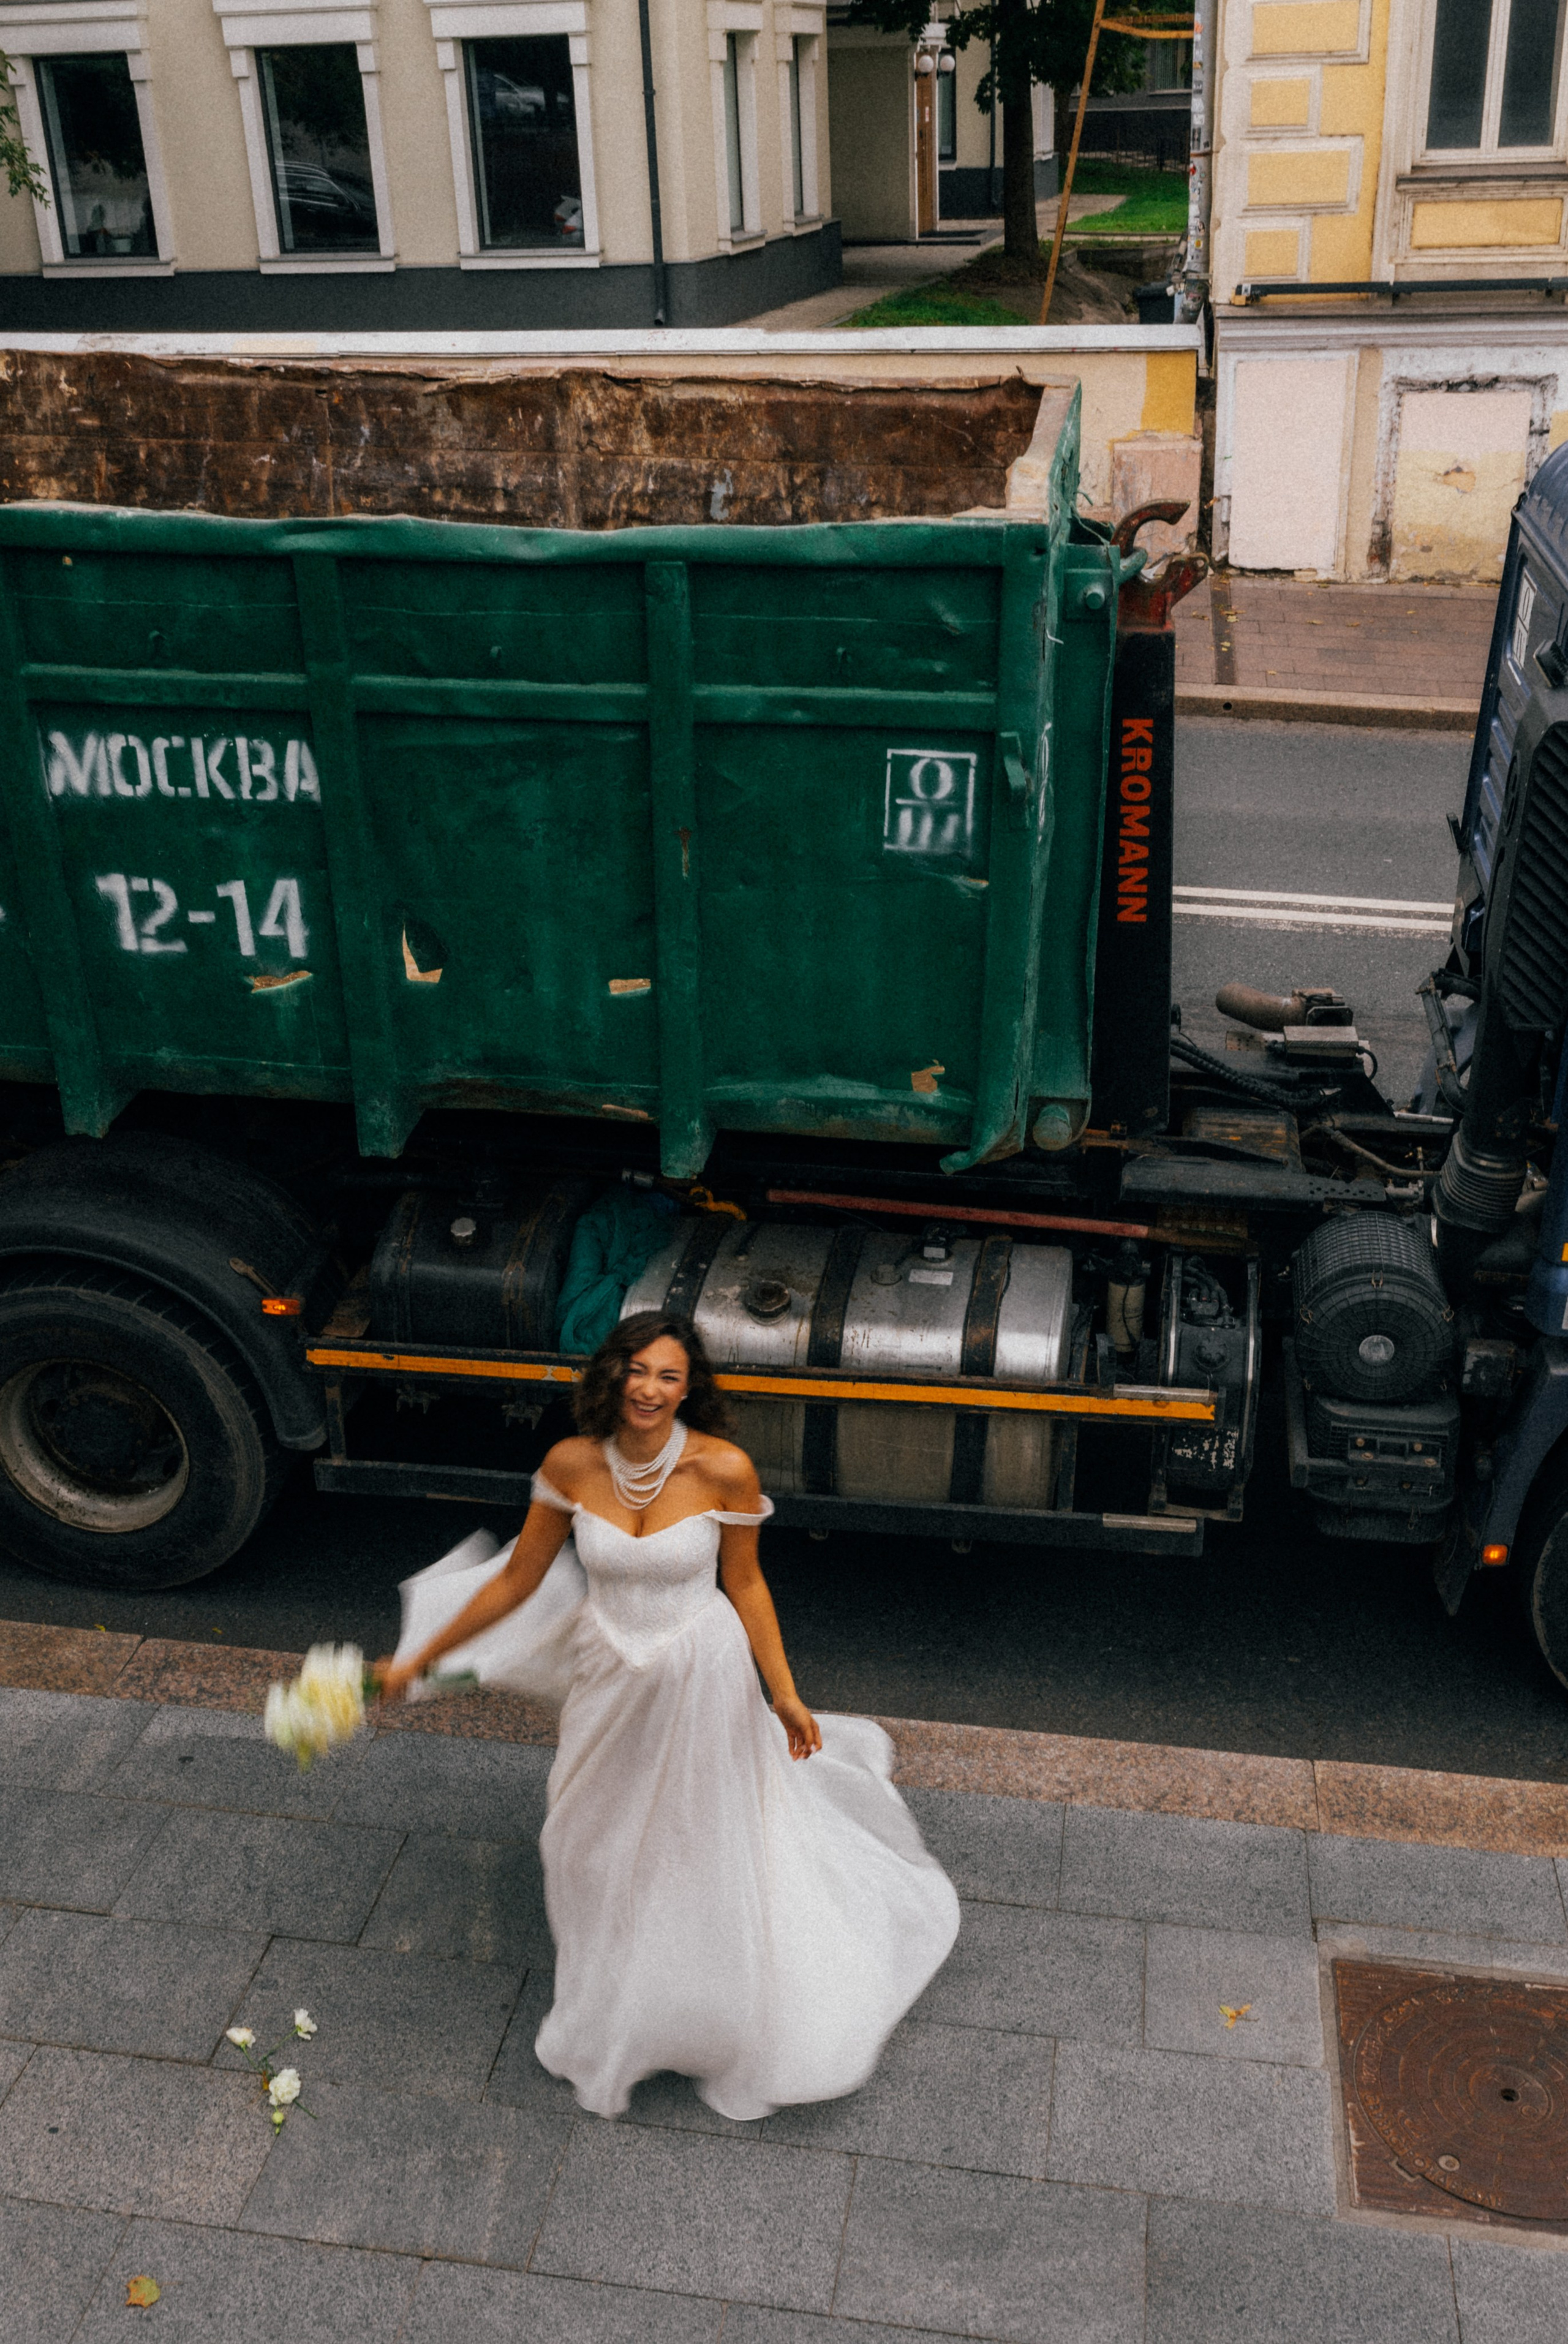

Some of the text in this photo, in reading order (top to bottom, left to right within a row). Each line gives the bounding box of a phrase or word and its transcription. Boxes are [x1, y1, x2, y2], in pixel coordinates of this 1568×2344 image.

[49, 731, 321, 802] МОСКВА
[1117, 718, 1154, 922] KROMANN
[95, 873, 308, 958] 12-14
